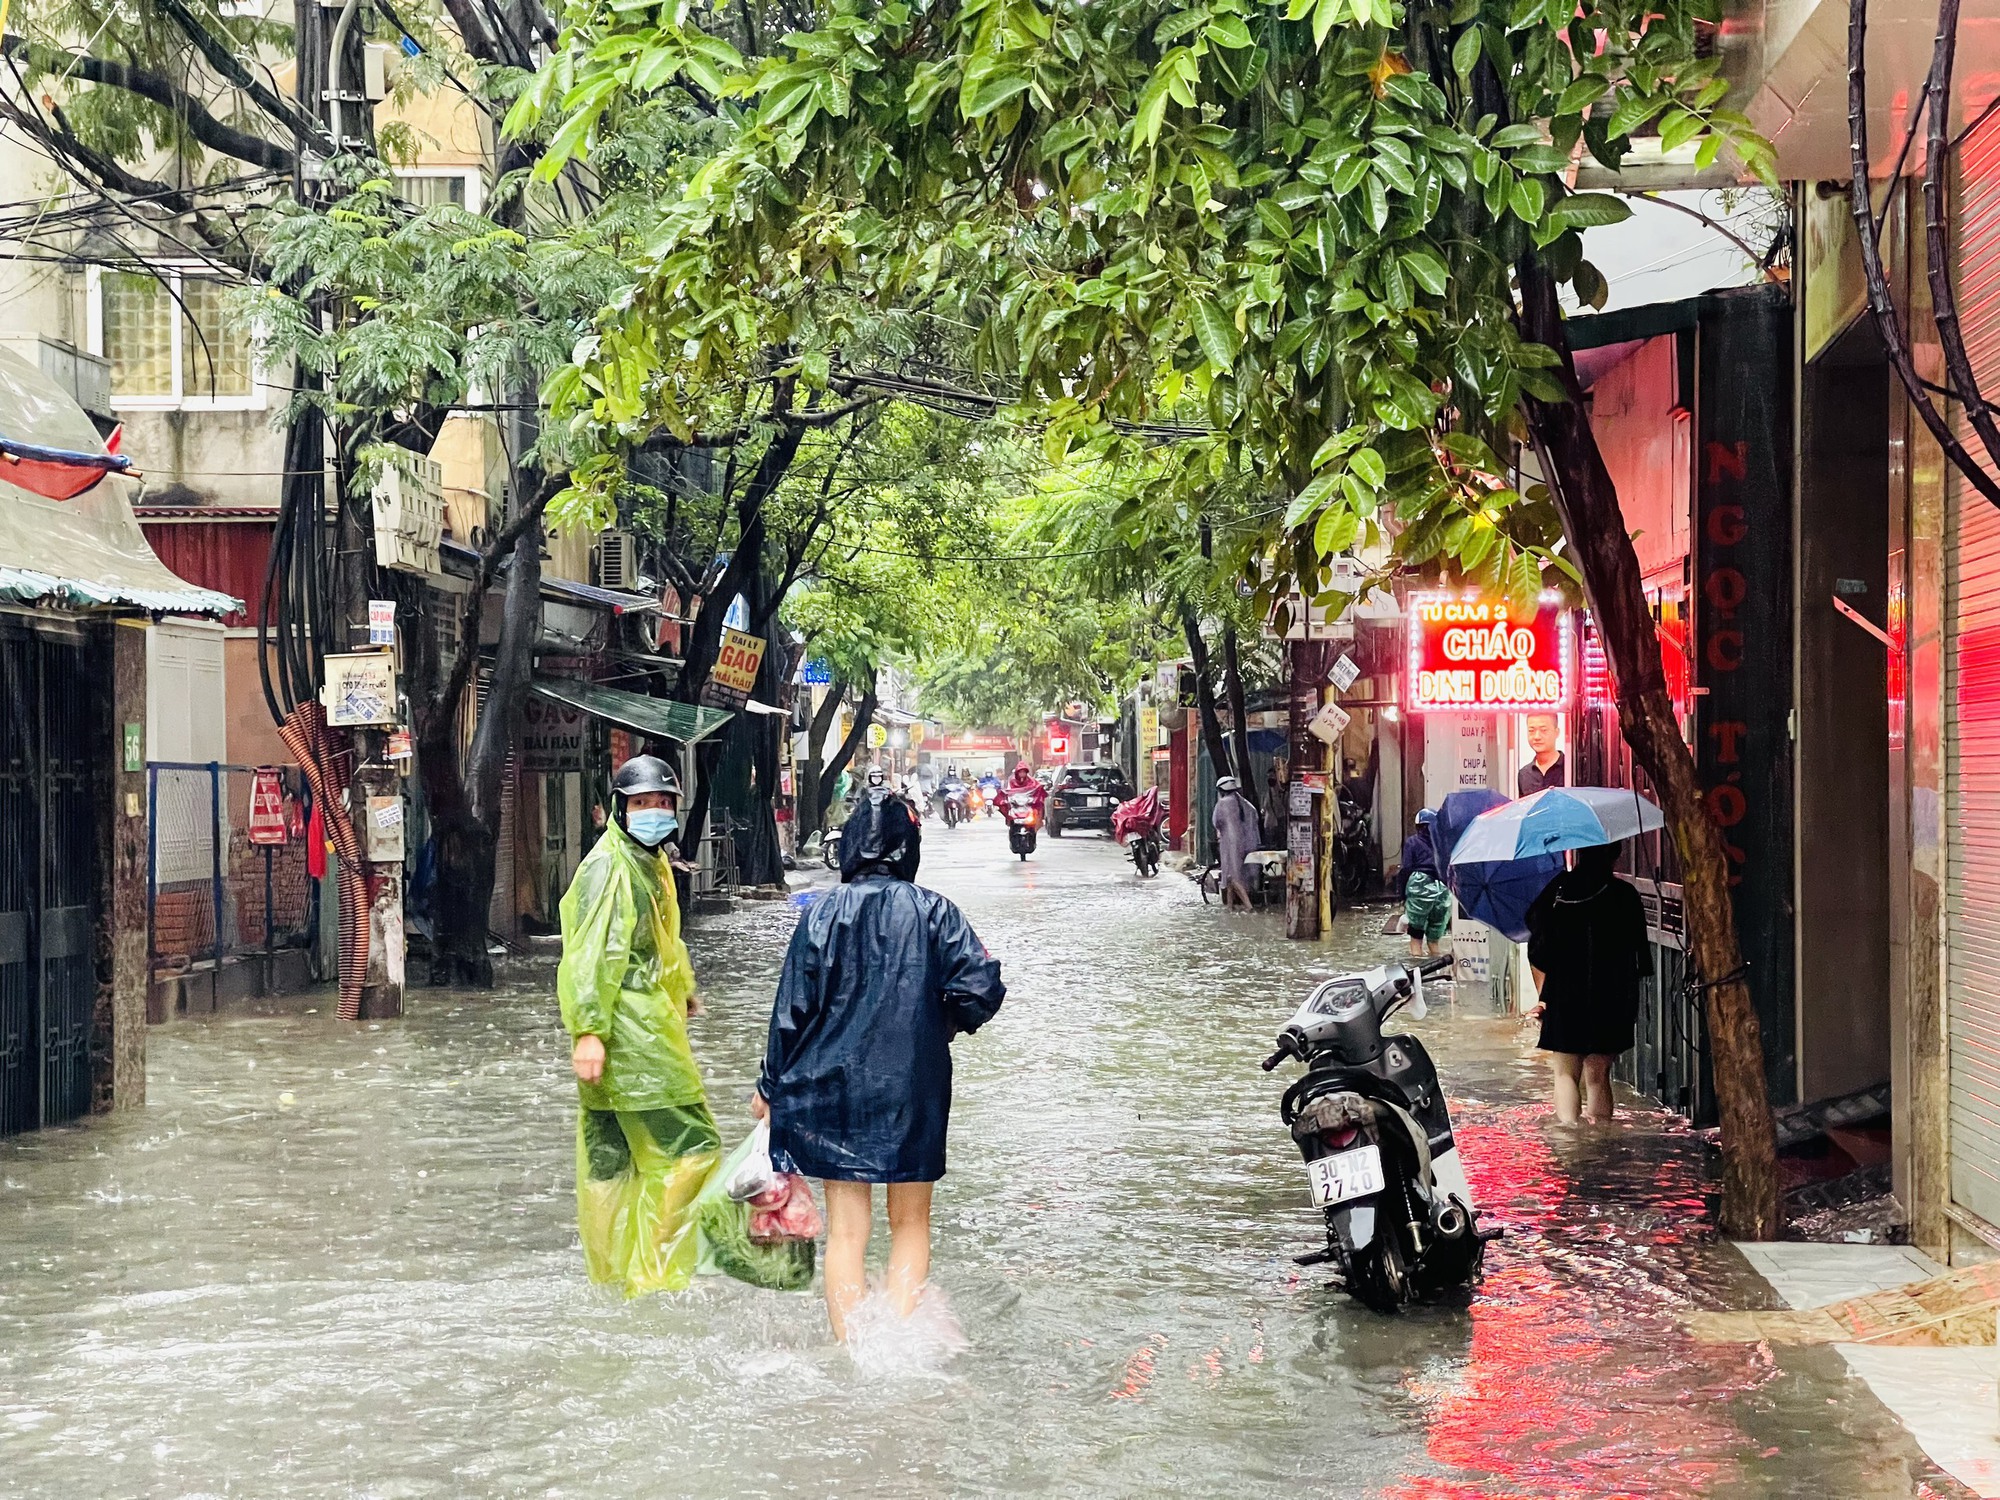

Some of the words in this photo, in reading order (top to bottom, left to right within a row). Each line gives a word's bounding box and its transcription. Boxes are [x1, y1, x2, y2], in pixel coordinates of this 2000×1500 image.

[1704, 441, 1749, 672] NGỌC
[1442, 620, 1536, 662] CHÁO
[720, 645, 759, 674] GẠO
[1418, 669, 1476, 702] DINH
[1461, 726, 1479, 737] QUAY
[125, 735, 140, 762] 56
[1321, 1171, 1373, 1203] 2740
